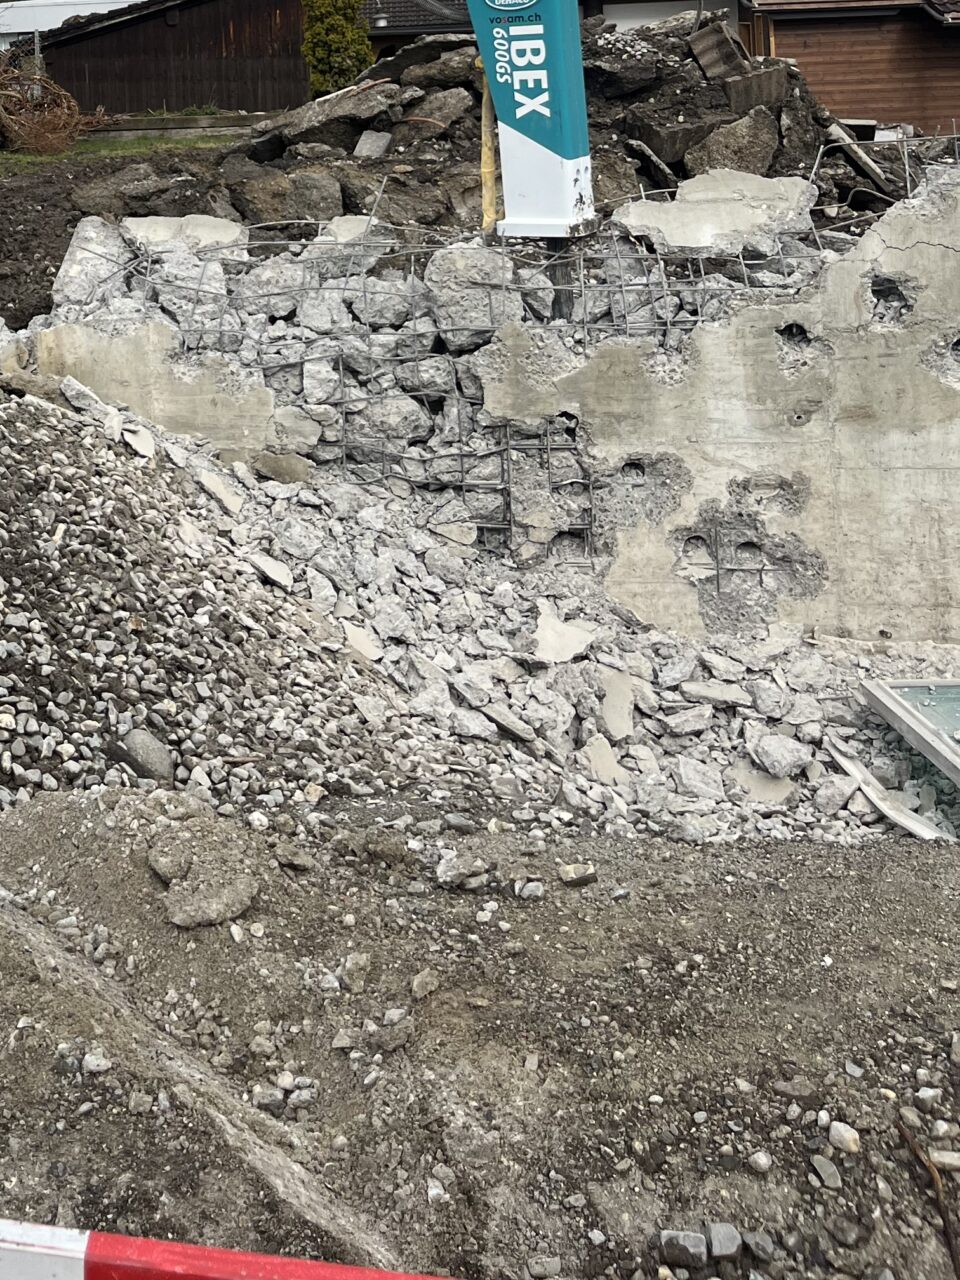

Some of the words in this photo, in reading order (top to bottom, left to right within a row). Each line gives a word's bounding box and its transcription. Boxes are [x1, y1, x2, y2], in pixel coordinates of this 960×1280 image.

[489, 13, 542, 24] vosam.ch
[493, 27, 512, 84] 600GS
[509, 24, 551, 119] IBEX
